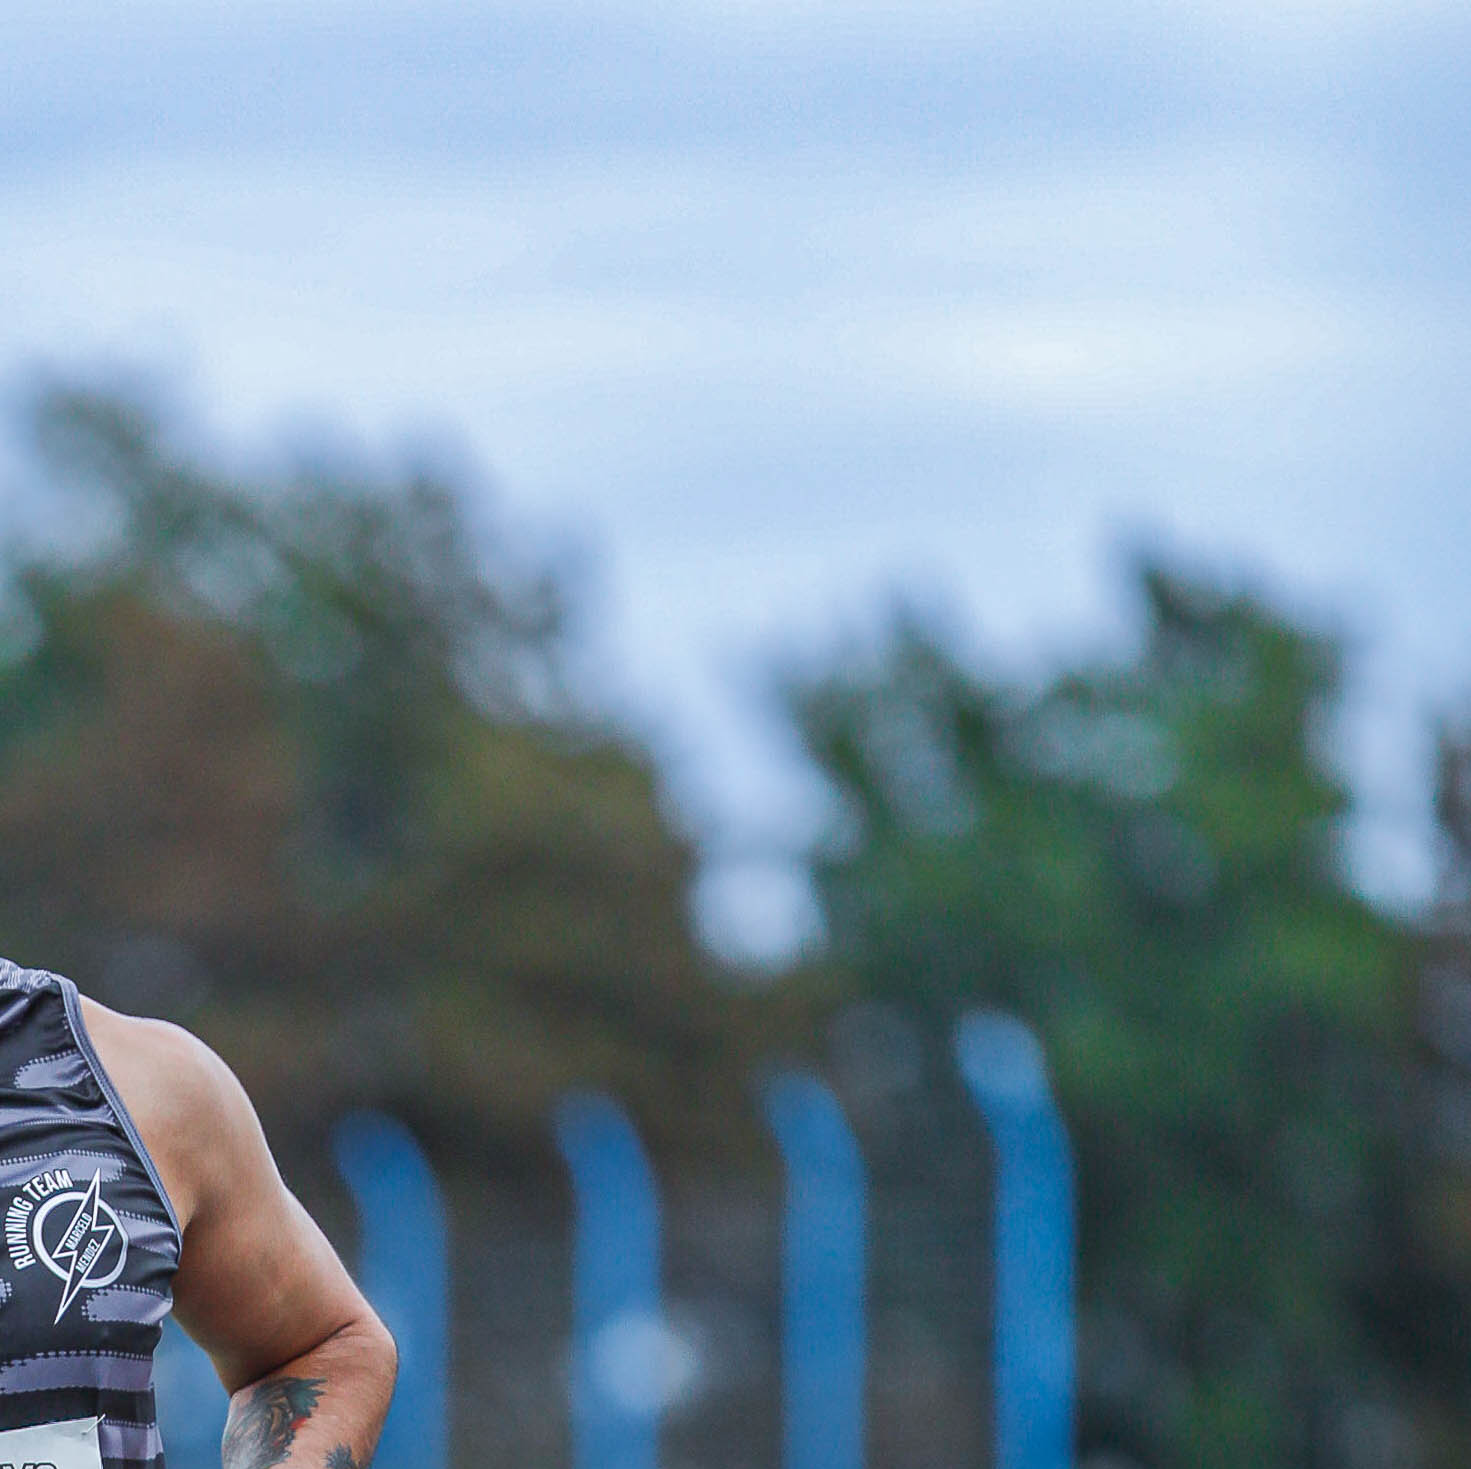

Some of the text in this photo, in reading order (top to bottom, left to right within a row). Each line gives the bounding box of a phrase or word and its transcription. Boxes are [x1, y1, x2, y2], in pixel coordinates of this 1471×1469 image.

[5, 1169, 74, 1270] RUNNING TEAM
[65, 1212, 93, 1250] MARCELO
[75, 1238, 101, 1274] MENDEZ
